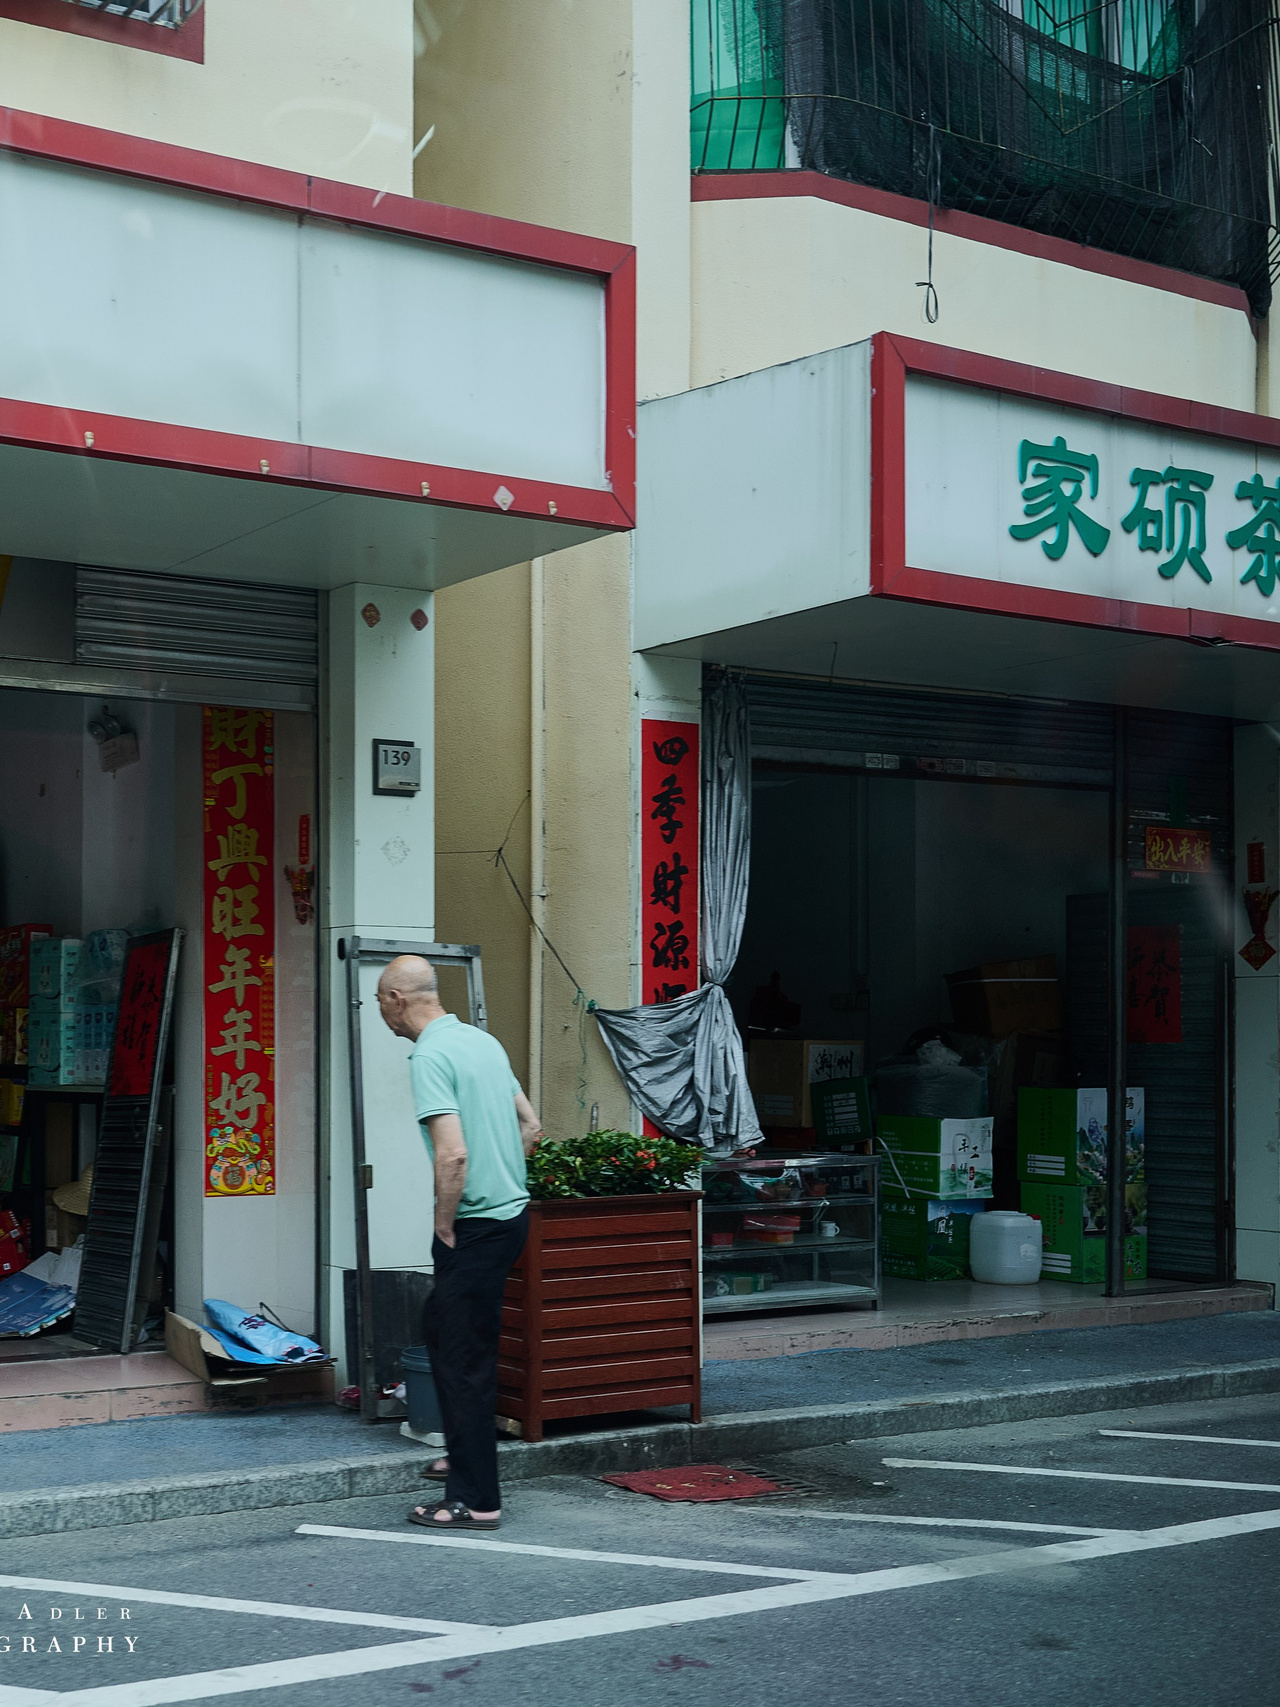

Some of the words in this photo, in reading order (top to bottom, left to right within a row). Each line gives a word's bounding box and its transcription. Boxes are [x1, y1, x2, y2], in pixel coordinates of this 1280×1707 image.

[1009, 436, 1280, 596] 家硕茶
[382, 749, 411, 766] 139
[1150, 834, 1206, 867] 出入平安
[208, 708, 268, 1129] 財丁興旺年年好
